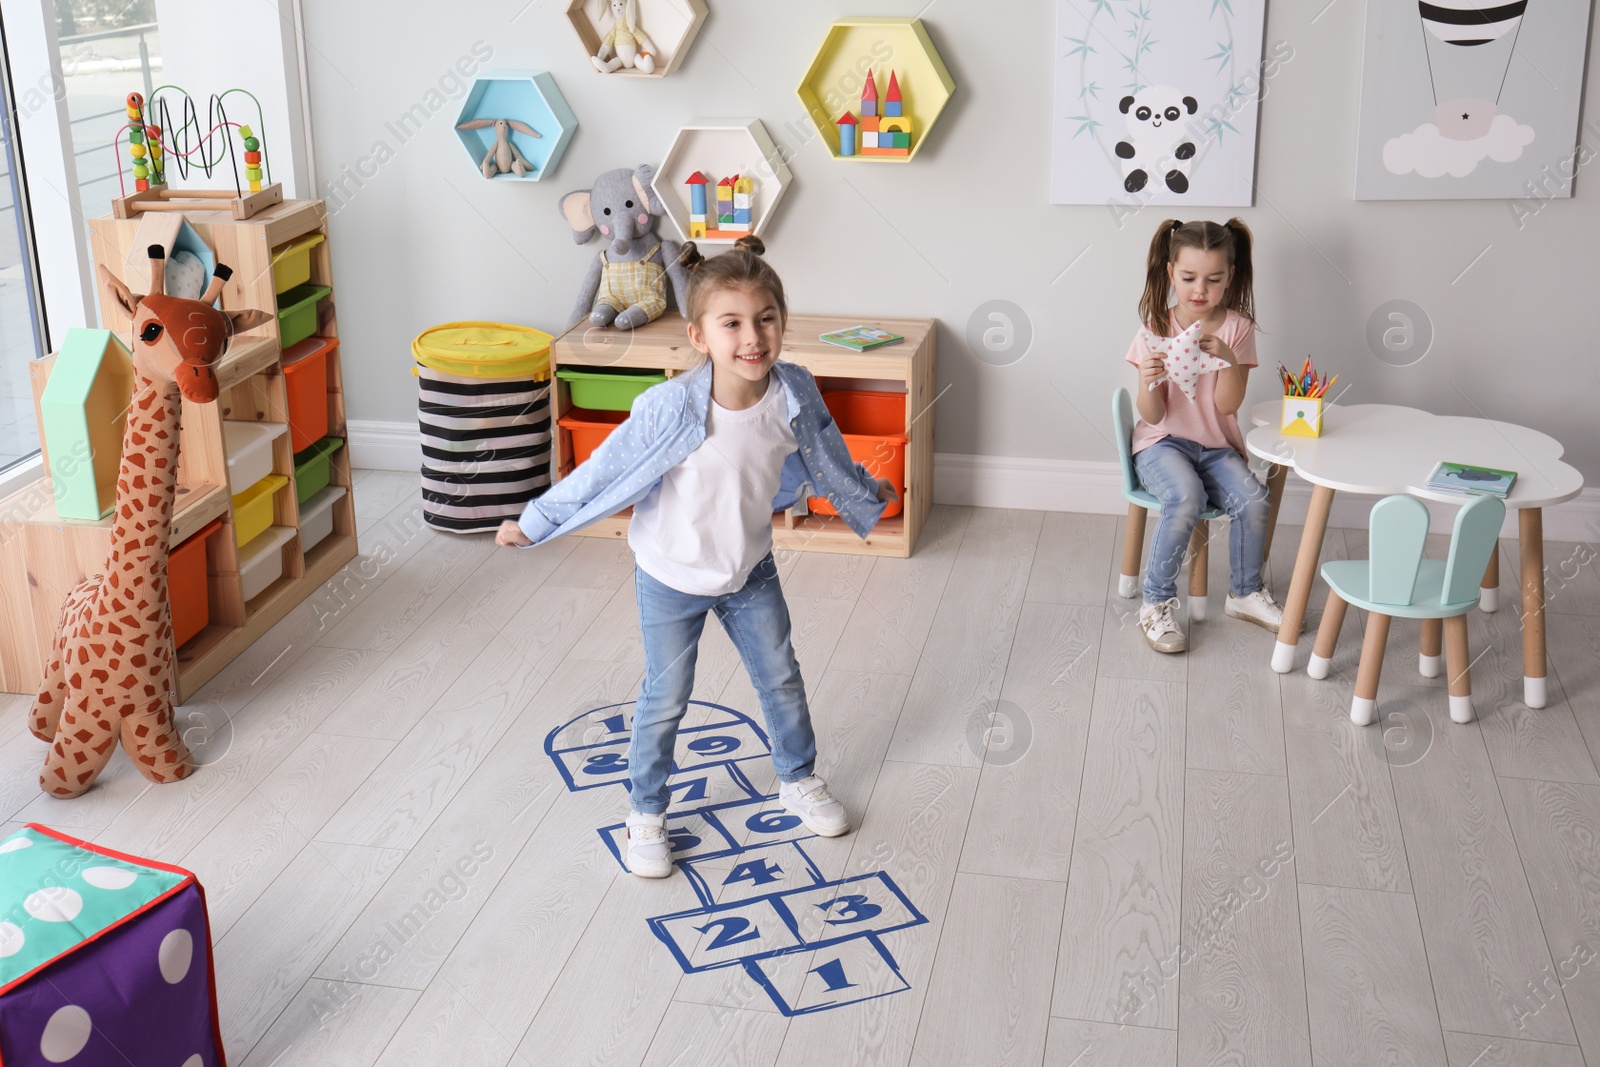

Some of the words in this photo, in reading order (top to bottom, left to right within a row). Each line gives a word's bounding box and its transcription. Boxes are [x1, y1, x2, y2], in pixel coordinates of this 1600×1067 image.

[687, 735, 742, 756] 9
[745, 808, 803, 834] 6
[721, 857, 785, 887] 4
[814, 895, 882, 926] 3
[692, 916, 760, 951] 2
[805, 957, 860, 994] 1
